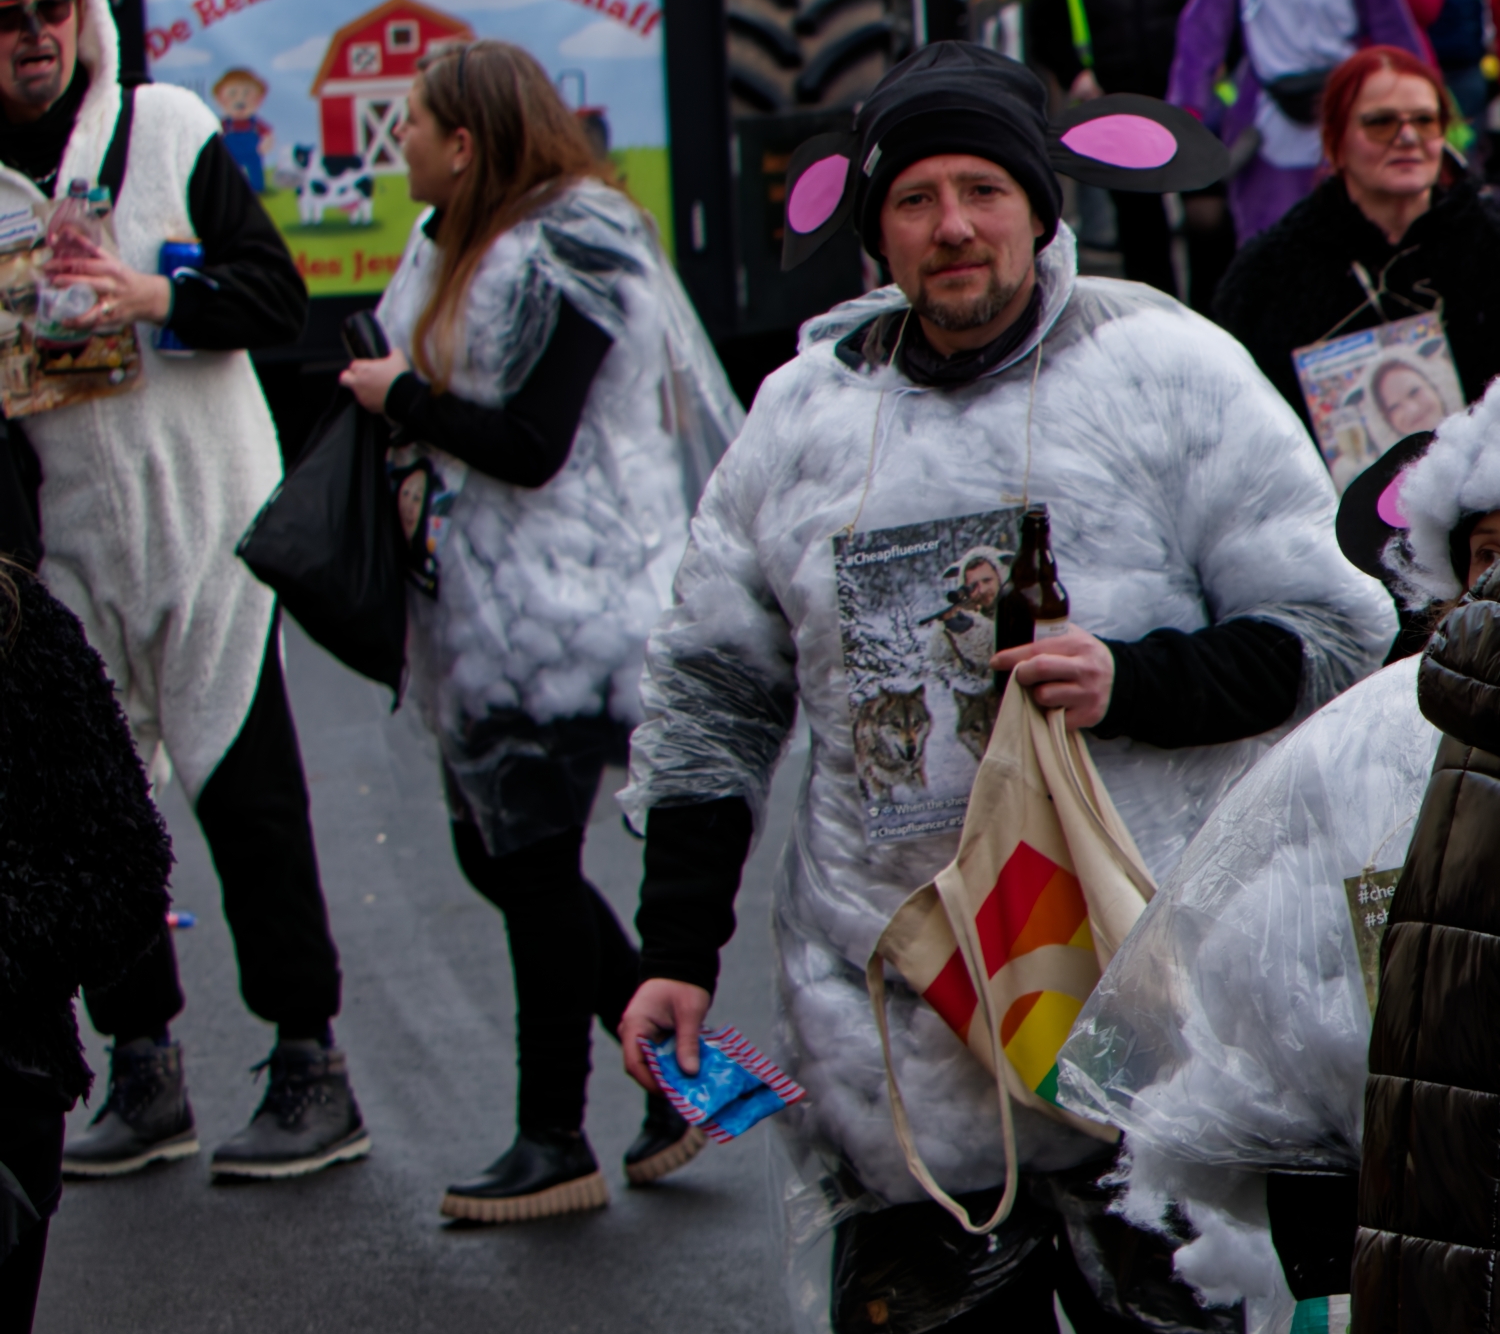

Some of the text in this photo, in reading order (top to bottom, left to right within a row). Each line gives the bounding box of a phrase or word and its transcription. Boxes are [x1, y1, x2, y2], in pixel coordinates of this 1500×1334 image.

[147, 20, 190, 60] De
[946, 796, 969, 807] shee
[1358, 884, 1397, 905] #che
